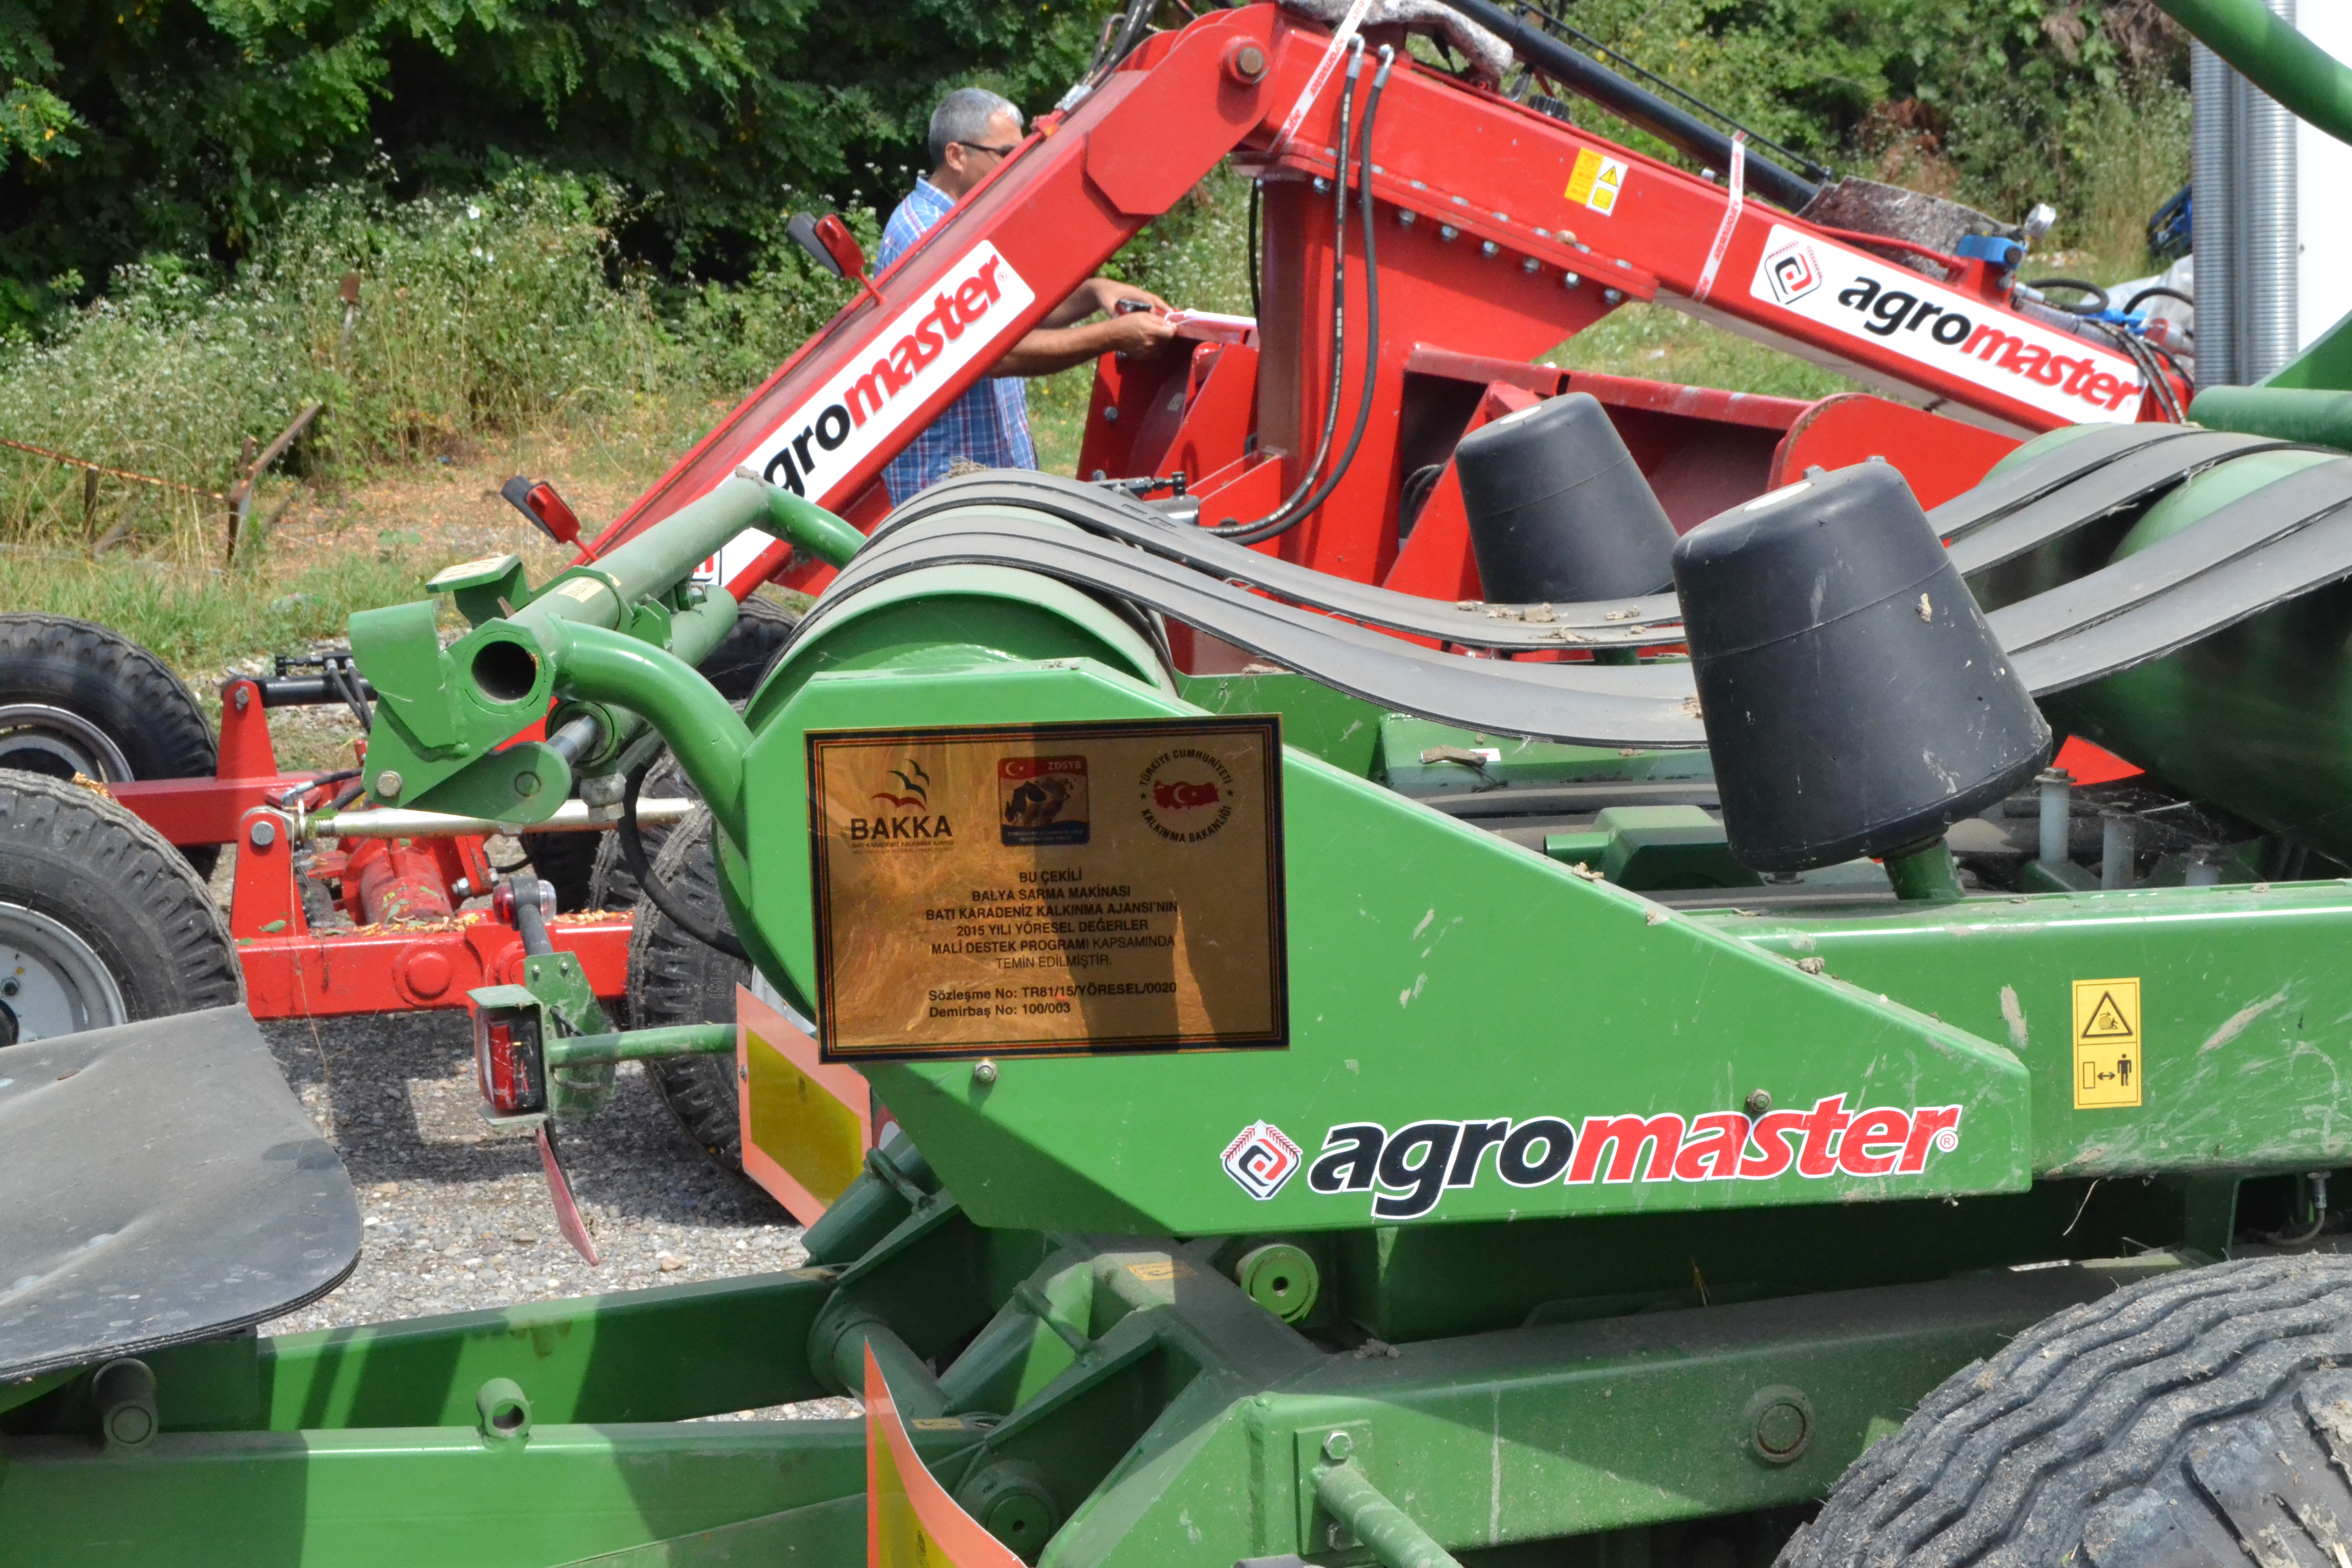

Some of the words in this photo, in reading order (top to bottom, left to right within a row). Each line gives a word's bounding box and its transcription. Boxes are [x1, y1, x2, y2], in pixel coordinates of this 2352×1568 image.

[1837, 276, 2143, 411] agromaster
[763, 254, 1001, 498] gromaster
[1048, 761, 1082, 770] ZDSYB
[1139, 752, 1171, 786] TÜRKİYE
[1172, 749, 1233, 784] CUMHURİYETİ
[851, 815, 952, 840] BAKKA
[1141, 808, 1185, 842] KALKINMA
[1188, 805, 1232, 842] BAKANLIĞI
[1019, 872, 1037, 883] BU
[1041, 867, 1082, 885] ÇEKİLİ
[972, 890, 1015, 901] BALYA
[1019, 888, 1065, 900] SARMA
[1068, 884, 1131, 898] MAKİNASI
[926, 909, 954, 920] BATI
[959, 904, 1033, 919] KARADENİZ
[1037, 903, 1103, 917] KALKINMA
[1107, 900, 1178, 914] AJANSI'NIN
[957, 925, 985, 937] 2015
[989, 924, 1011, 935] YILI
[1015, 921, 1075, 935] YÖRESEL
[1079, 918, 1148, 933] DEĞERLER
[932, 940, 962, 954] MALİ
[966, 941, 1017, 953] DESTEK
[1021, 938, 1089, 951] PROGRAMI
[1093, 935, 1175, 949] KAPSAMINDA
[996, 955, 1034, 969] TEMİN
[1039, 951, 1112, 969] EDİLMİŞTİR.
[929, 990, 991, 1002] Sözleşme
[995, 988, 1017, 998] No:
[1021, 982, 1177, 997] TR81/15/YÖRESEL/0020
[929, 1006, 991, 1018] Demirbaş
[995, 1004, 1017, 1015] No:
[1022, 1002, 1070, 1014] 100/003
[1308, 1093, 1963, 1219] agromaster
